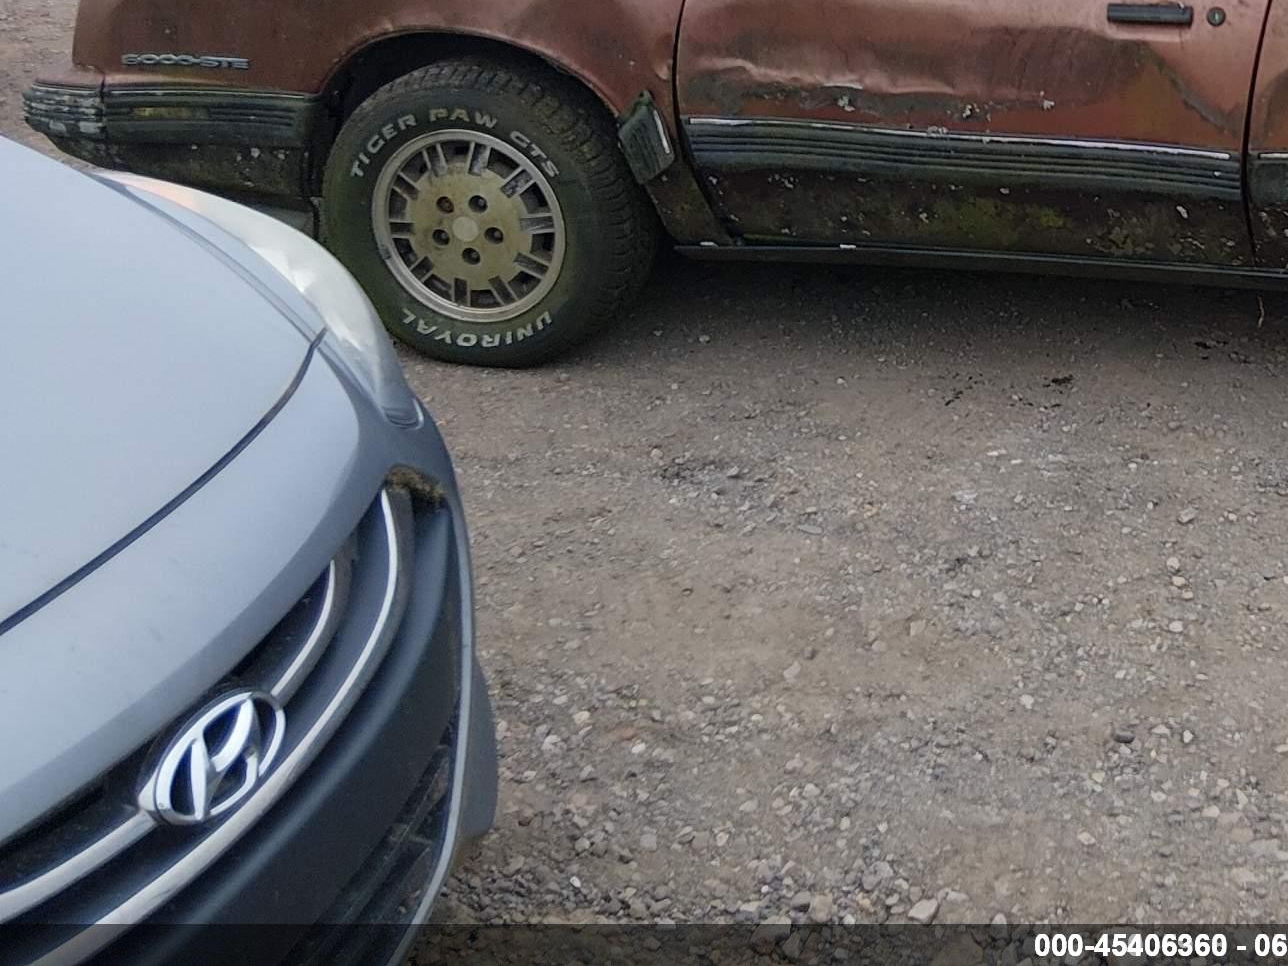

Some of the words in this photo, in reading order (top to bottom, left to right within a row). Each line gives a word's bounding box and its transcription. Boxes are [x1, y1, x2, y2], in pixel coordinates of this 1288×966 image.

[350, 113, 418, 178] TIGER
[428, 107, 499, 129] PAW
[508, 129, 561, 179] GTS
[401, 307, 553, 348] UNIROYAL
